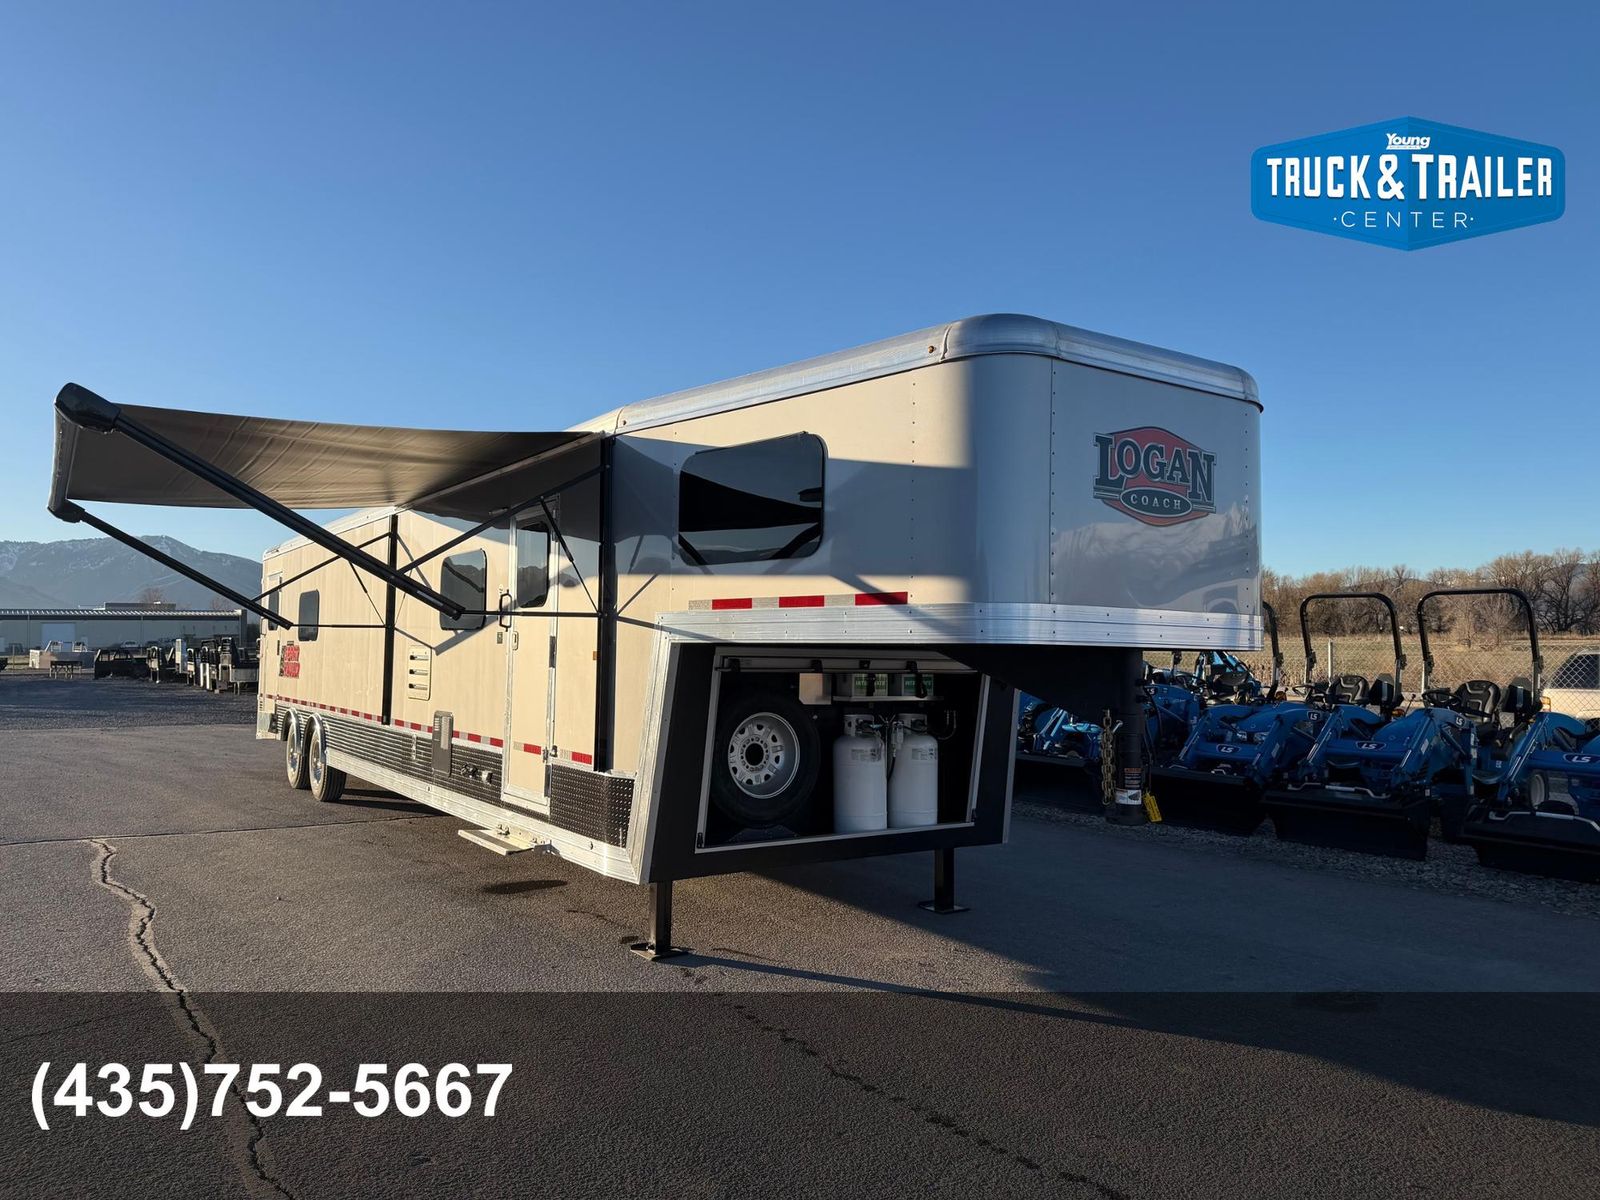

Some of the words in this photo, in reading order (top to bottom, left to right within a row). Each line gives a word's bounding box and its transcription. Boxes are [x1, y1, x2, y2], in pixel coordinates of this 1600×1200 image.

[1093, 432, 1217, 503] LOGAN
[1130, 494, 1182, 510] COACH
[1309, 712, 1319, 721] LS
[1221, 746, 1234, 754] LS
